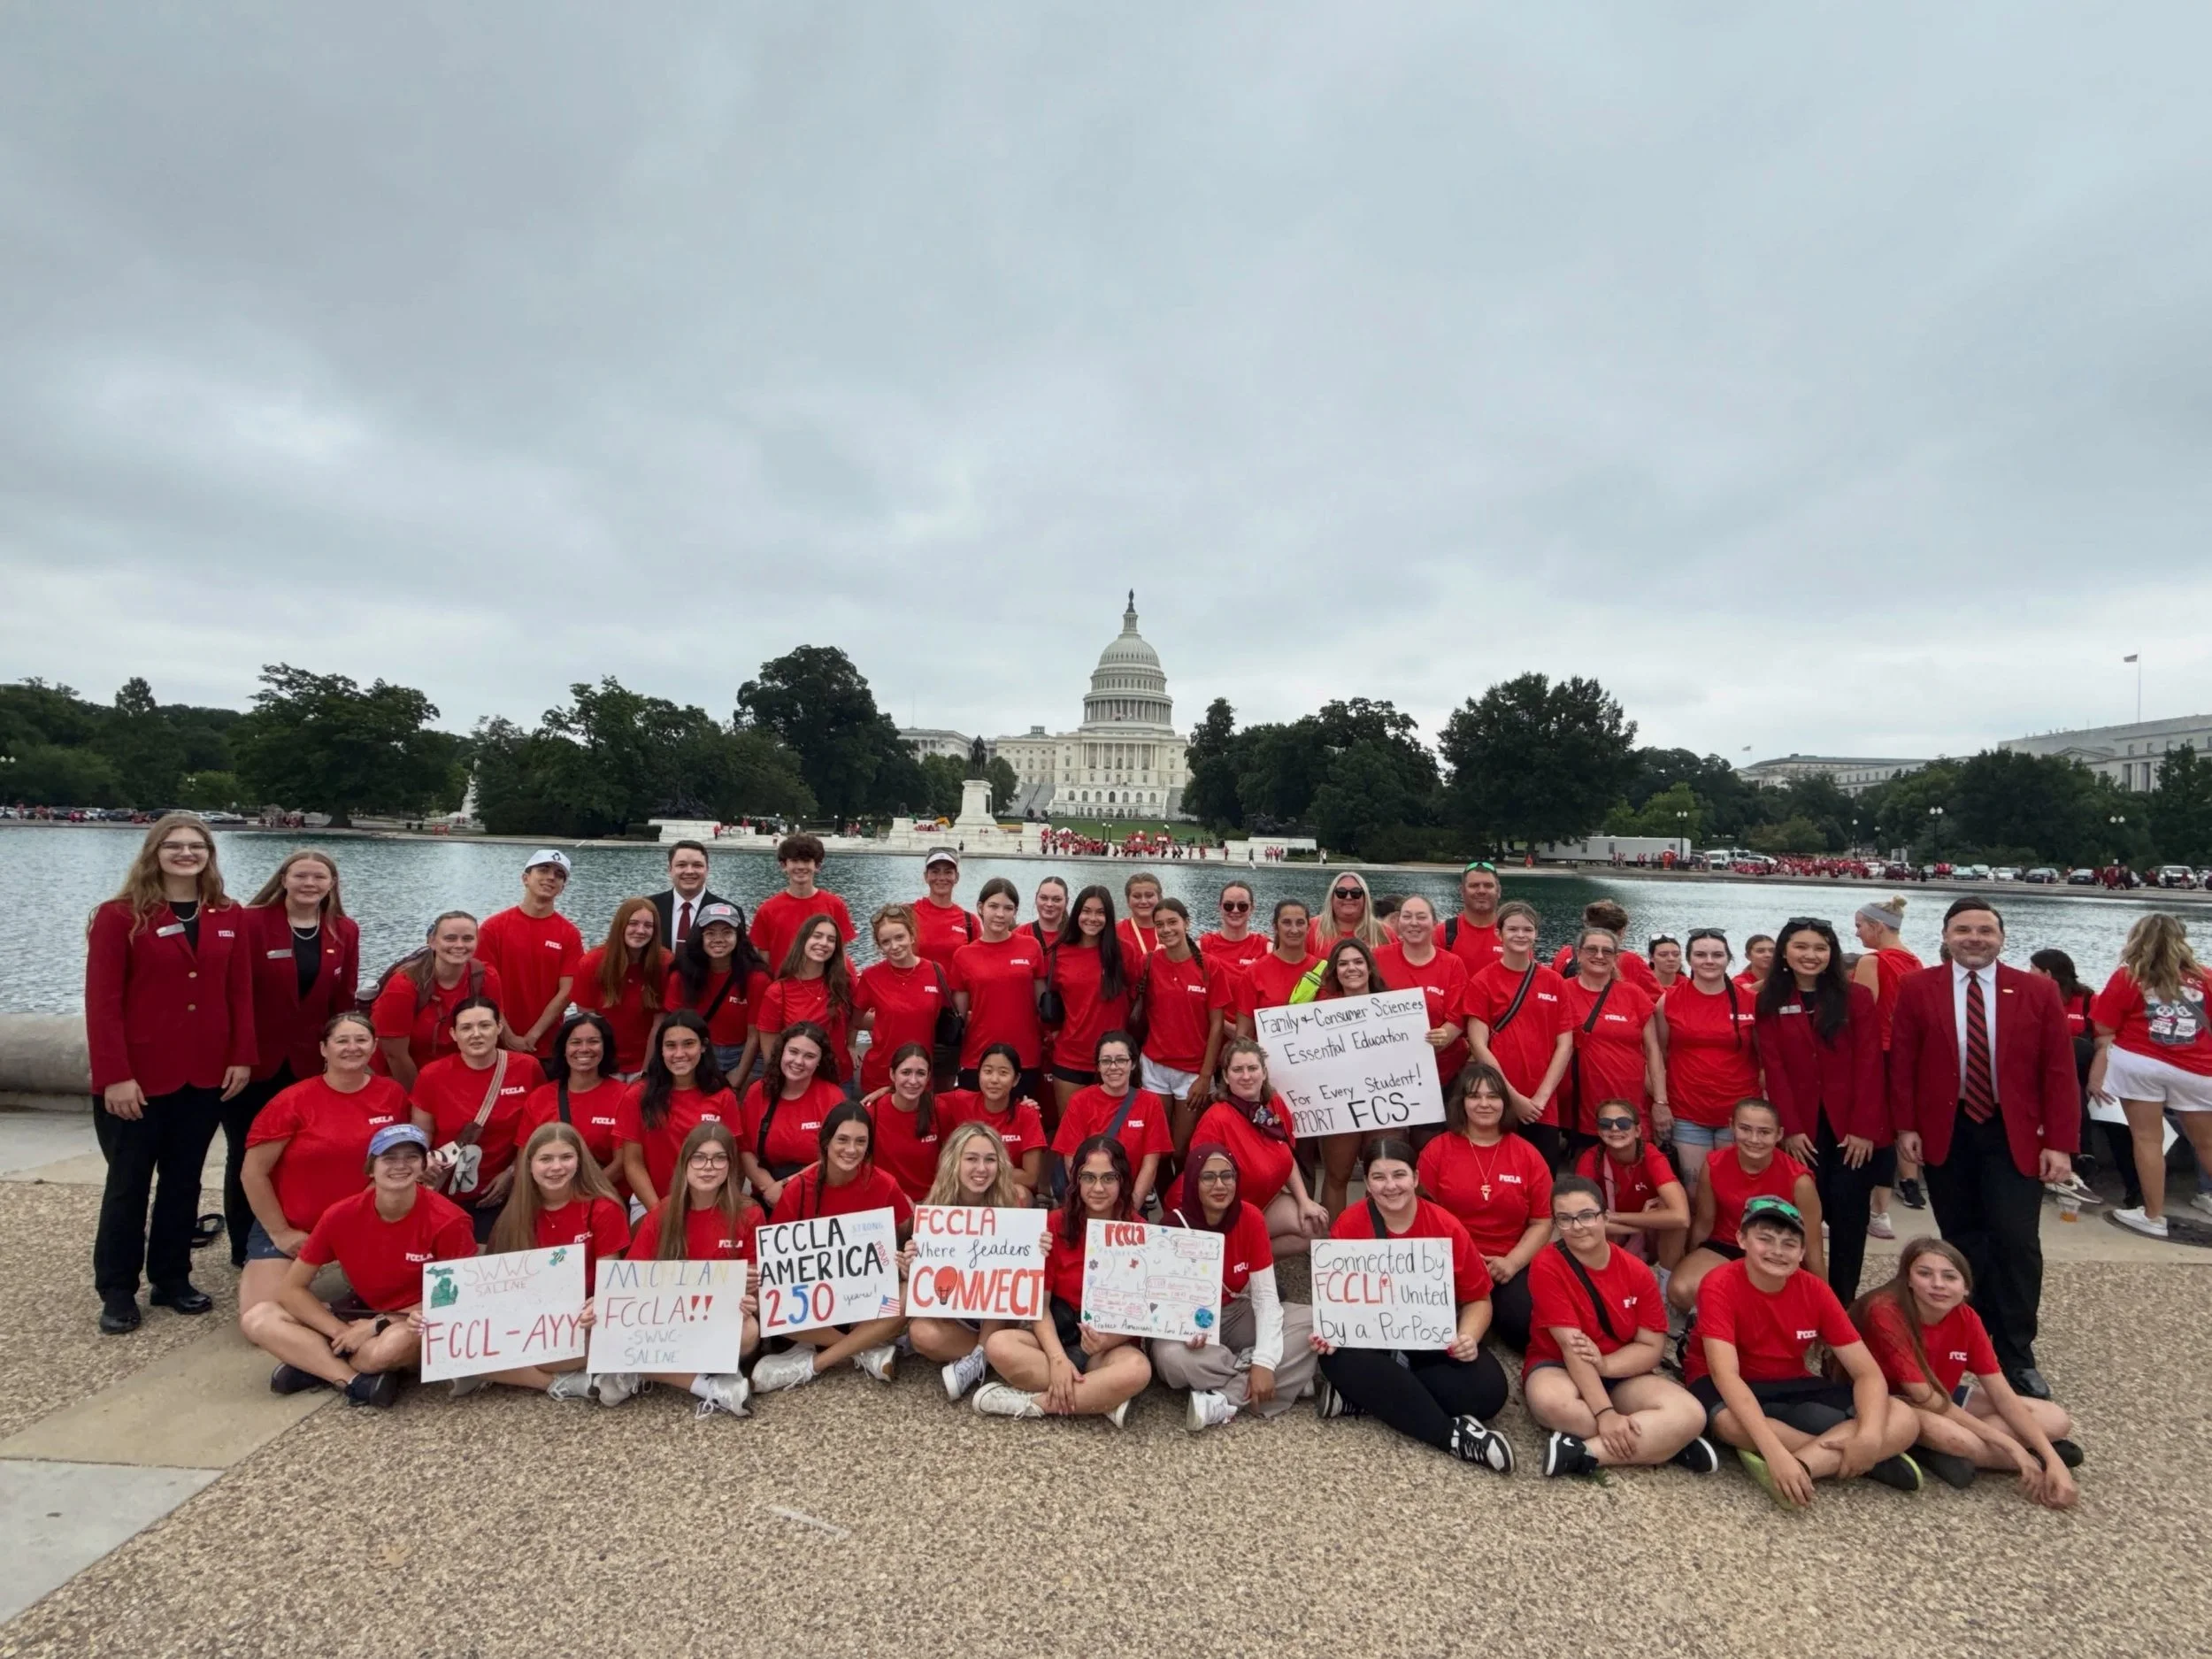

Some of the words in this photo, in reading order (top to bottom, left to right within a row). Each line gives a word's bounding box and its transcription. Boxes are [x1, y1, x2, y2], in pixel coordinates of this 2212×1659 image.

[1257, 1009, 1299, 1034] Family
[1314, 1007, 1368, 1028] Consumer
[1371, 997, 1424, 1018] Sciences
[1284, 1033, 1346, 1064] Essential
[1352, 1026, 1409, 1051] Education
[501, 1087, 525, 1095] FCCLA
[1286, 1090, 1310, 1107] For
[1319, 1084, 1354, 1101] Every
[1364, 1063, 1423, 1094] Student!
[369, 1116, 394, 1125] FCCLA
[591, 1117, 616, 1125] FCCLA
[1499, 1174, 1521, 1184] FCCLA
[758, 1217, 846, 1257] FCCLA
[914, 1207, 995, 1236] FCCLA
[759, 1242, 883, 1287] AMERICA
[1314, 1240, 1416, 1274] Connected
[1423, 1242, 1445, 1280] by
[765, 1282, 834, 1328] 250
[1315, 1271, 1394, 1305] FCCLA
[1401, 1282, 1449, 1307] United
[604, 1294, 713, 1329] FCCLA!!
[1319, 1309, 1346, 1346] by
